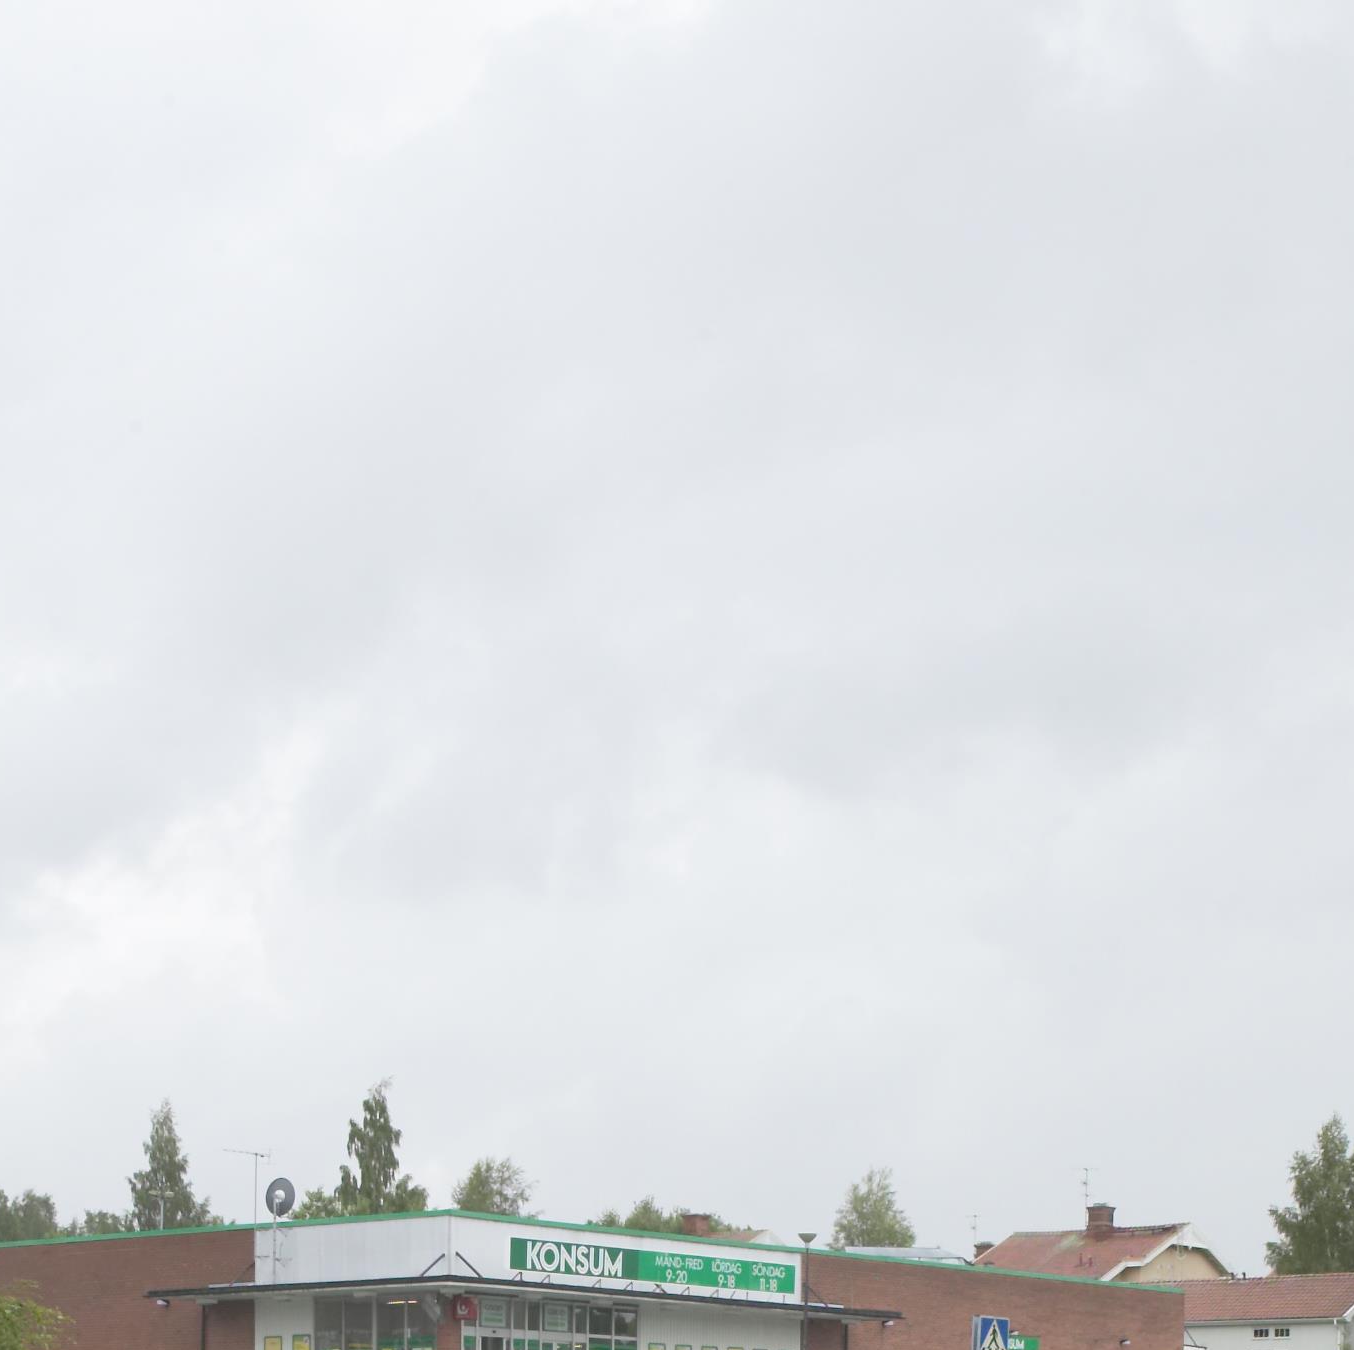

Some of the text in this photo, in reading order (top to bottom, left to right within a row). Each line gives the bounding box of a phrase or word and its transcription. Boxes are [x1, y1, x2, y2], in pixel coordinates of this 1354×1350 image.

[526, 1240, 623, 1278] KONSUM
[711, 1258, 742, 1275] LÖRDAG
[751, 1262, 786, 1279] SÖNDAG
[665, 1268, 778, 1293] 9-20 9-18 11-18
